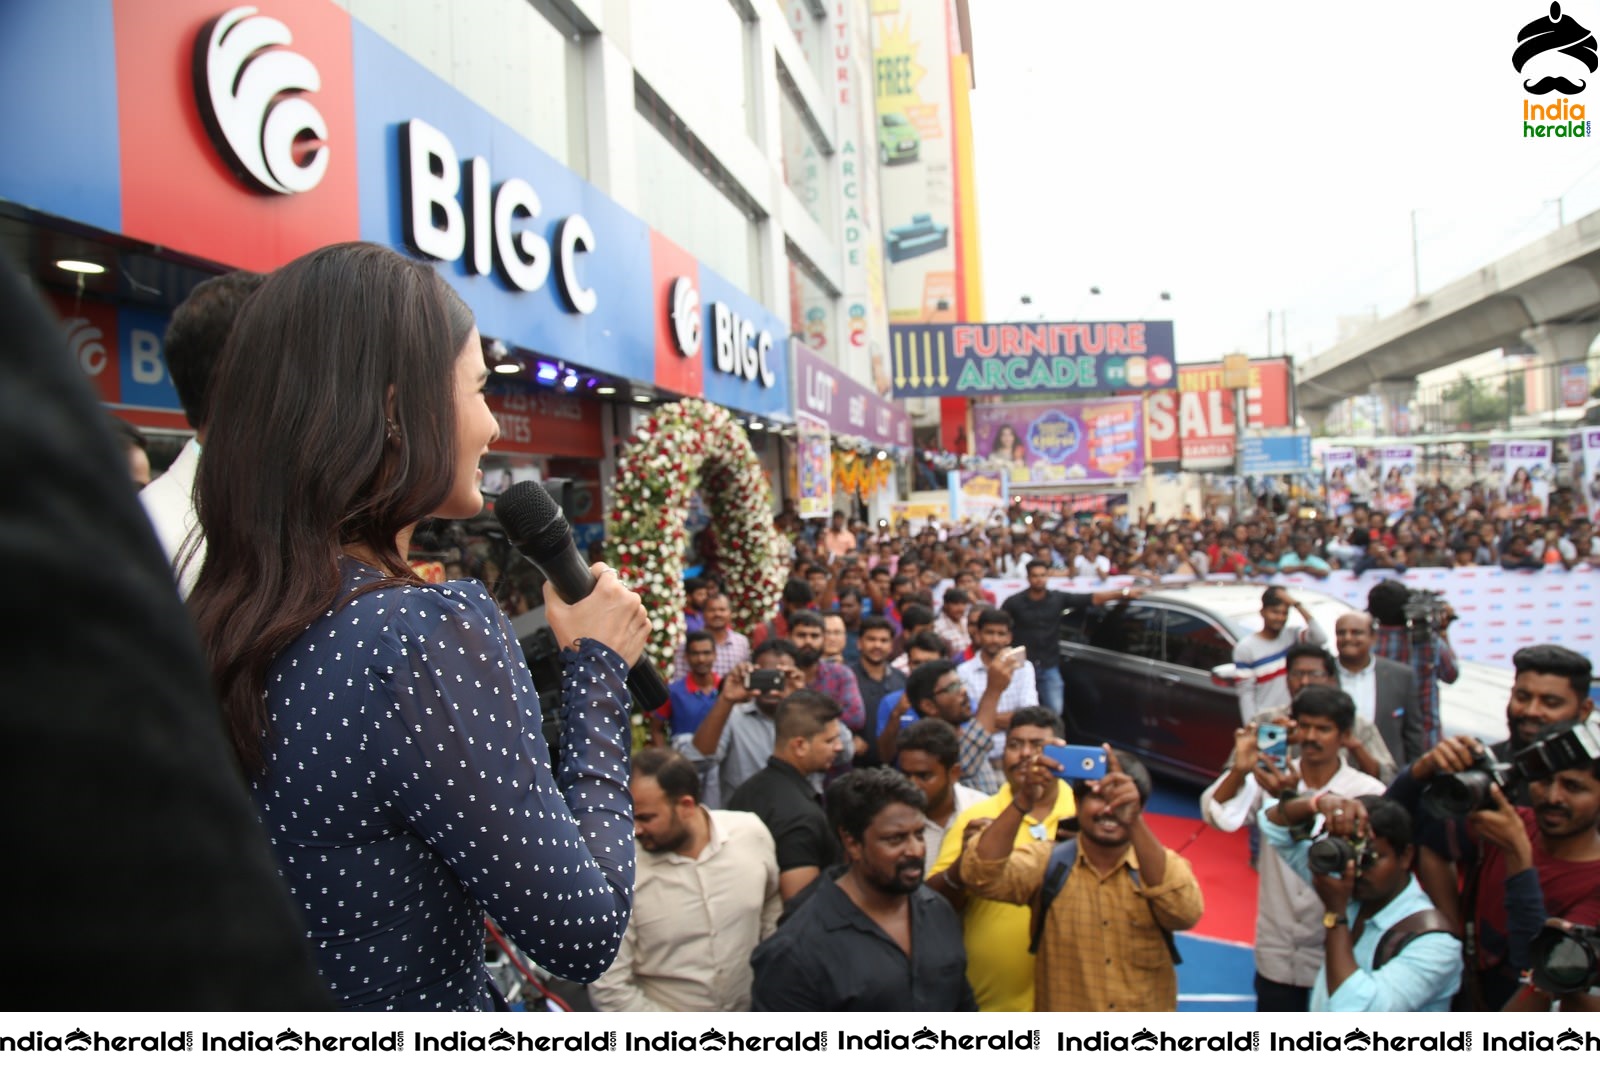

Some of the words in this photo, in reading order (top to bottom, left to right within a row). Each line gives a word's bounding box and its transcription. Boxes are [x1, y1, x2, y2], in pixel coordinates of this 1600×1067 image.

[877, 55, 913, 96] FREE
[401, 117, 552, 292] BIG
[556, 213, 597, 315] C
[842, 140, 860, 266] ARCADE
[712, 300, 758, 382] BIG
[758, 329, 775, 388] C
[952, 322, 1147, 358] FURNITURE
[956, 355, 1098, 391] ARCADE
[1150, 386, 1265, 441] SALE
